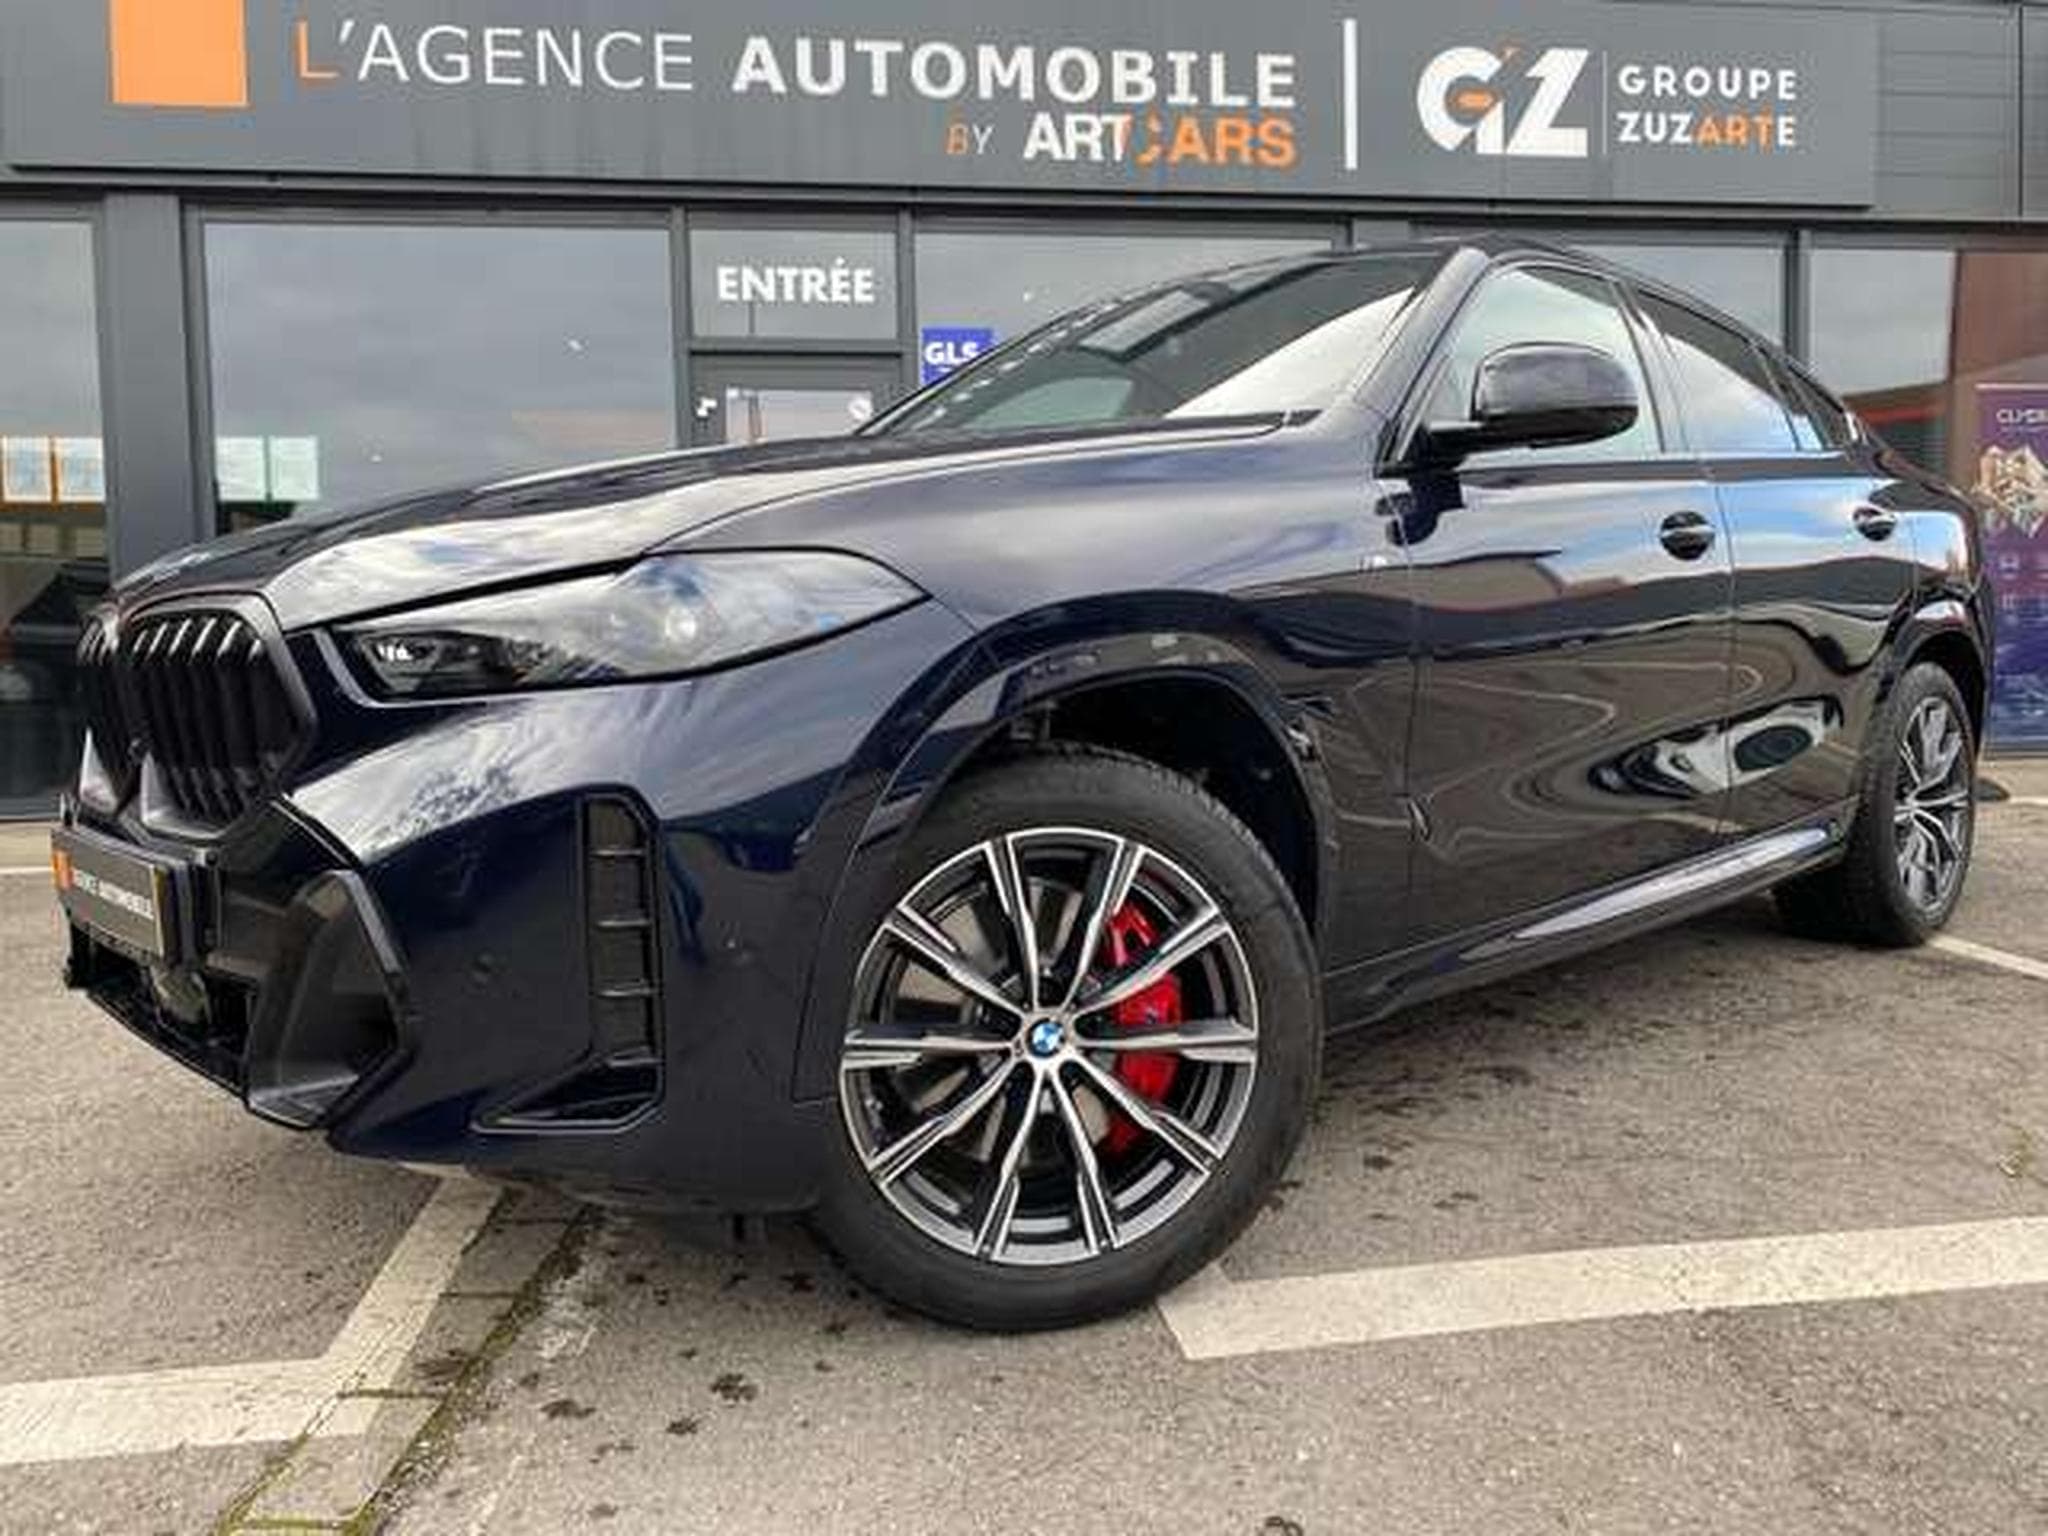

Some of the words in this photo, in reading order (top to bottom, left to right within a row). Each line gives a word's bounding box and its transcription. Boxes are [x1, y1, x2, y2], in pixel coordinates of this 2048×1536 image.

[731, 34, 1297, 109] AUTOMOBILE
[1617, 65, 1798, 101] GROUPE
[946, 121, 994, 156] BY
[1616, 110, 1798, 148] ZUZARTE
[716, 256, 876, 303] ENTRÉE
[924, 341, 980, 365] GLS
